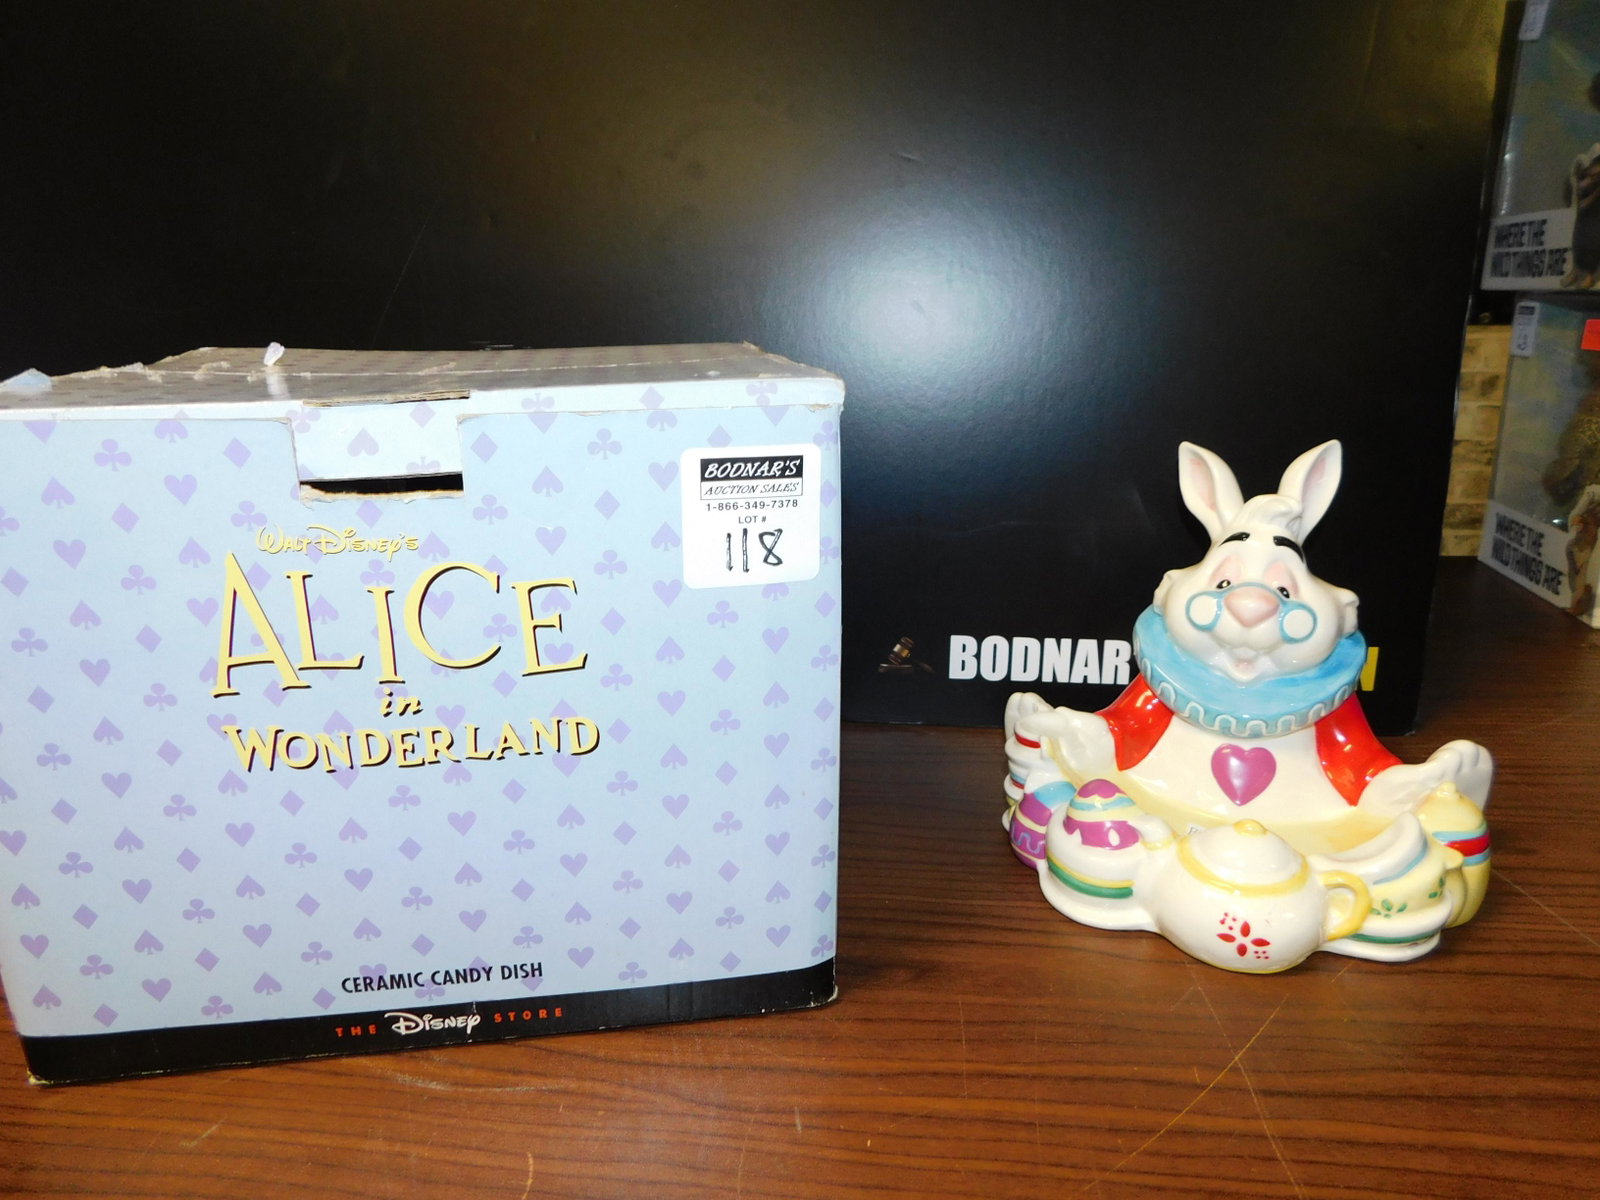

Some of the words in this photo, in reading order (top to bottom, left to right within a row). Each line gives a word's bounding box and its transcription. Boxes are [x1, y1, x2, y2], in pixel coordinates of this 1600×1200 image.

[704, 458, 801, 479] BODNAR'S
[704, 483, 759, 496] AUCTION
[760, 482, 800, 494] SALES
[706, 499, 799, 512] 1-866-349-7378
[738, 516, 758, 524] LOT
[761, 515, 767, 523] #
[725, 527, 784, 573] 118
[1496, 512, 1526, 548] WHERE
[1526, 527, 1544, 558] THE
[1542, 564, 1564, 595] ARE
[210, 551, 589, 698] ALICE
[379, 686, 424, 718] in
[221, 716, 601, 774] WONDERLAND
[341, 971, 425, 994] CERAMIC
[430, 966, 493, 986] CANDY
[501, 962, 543, 980] DISH
[335, 1024, 377, 1038] THE
[494, 1007, 563, 1023] STORE
